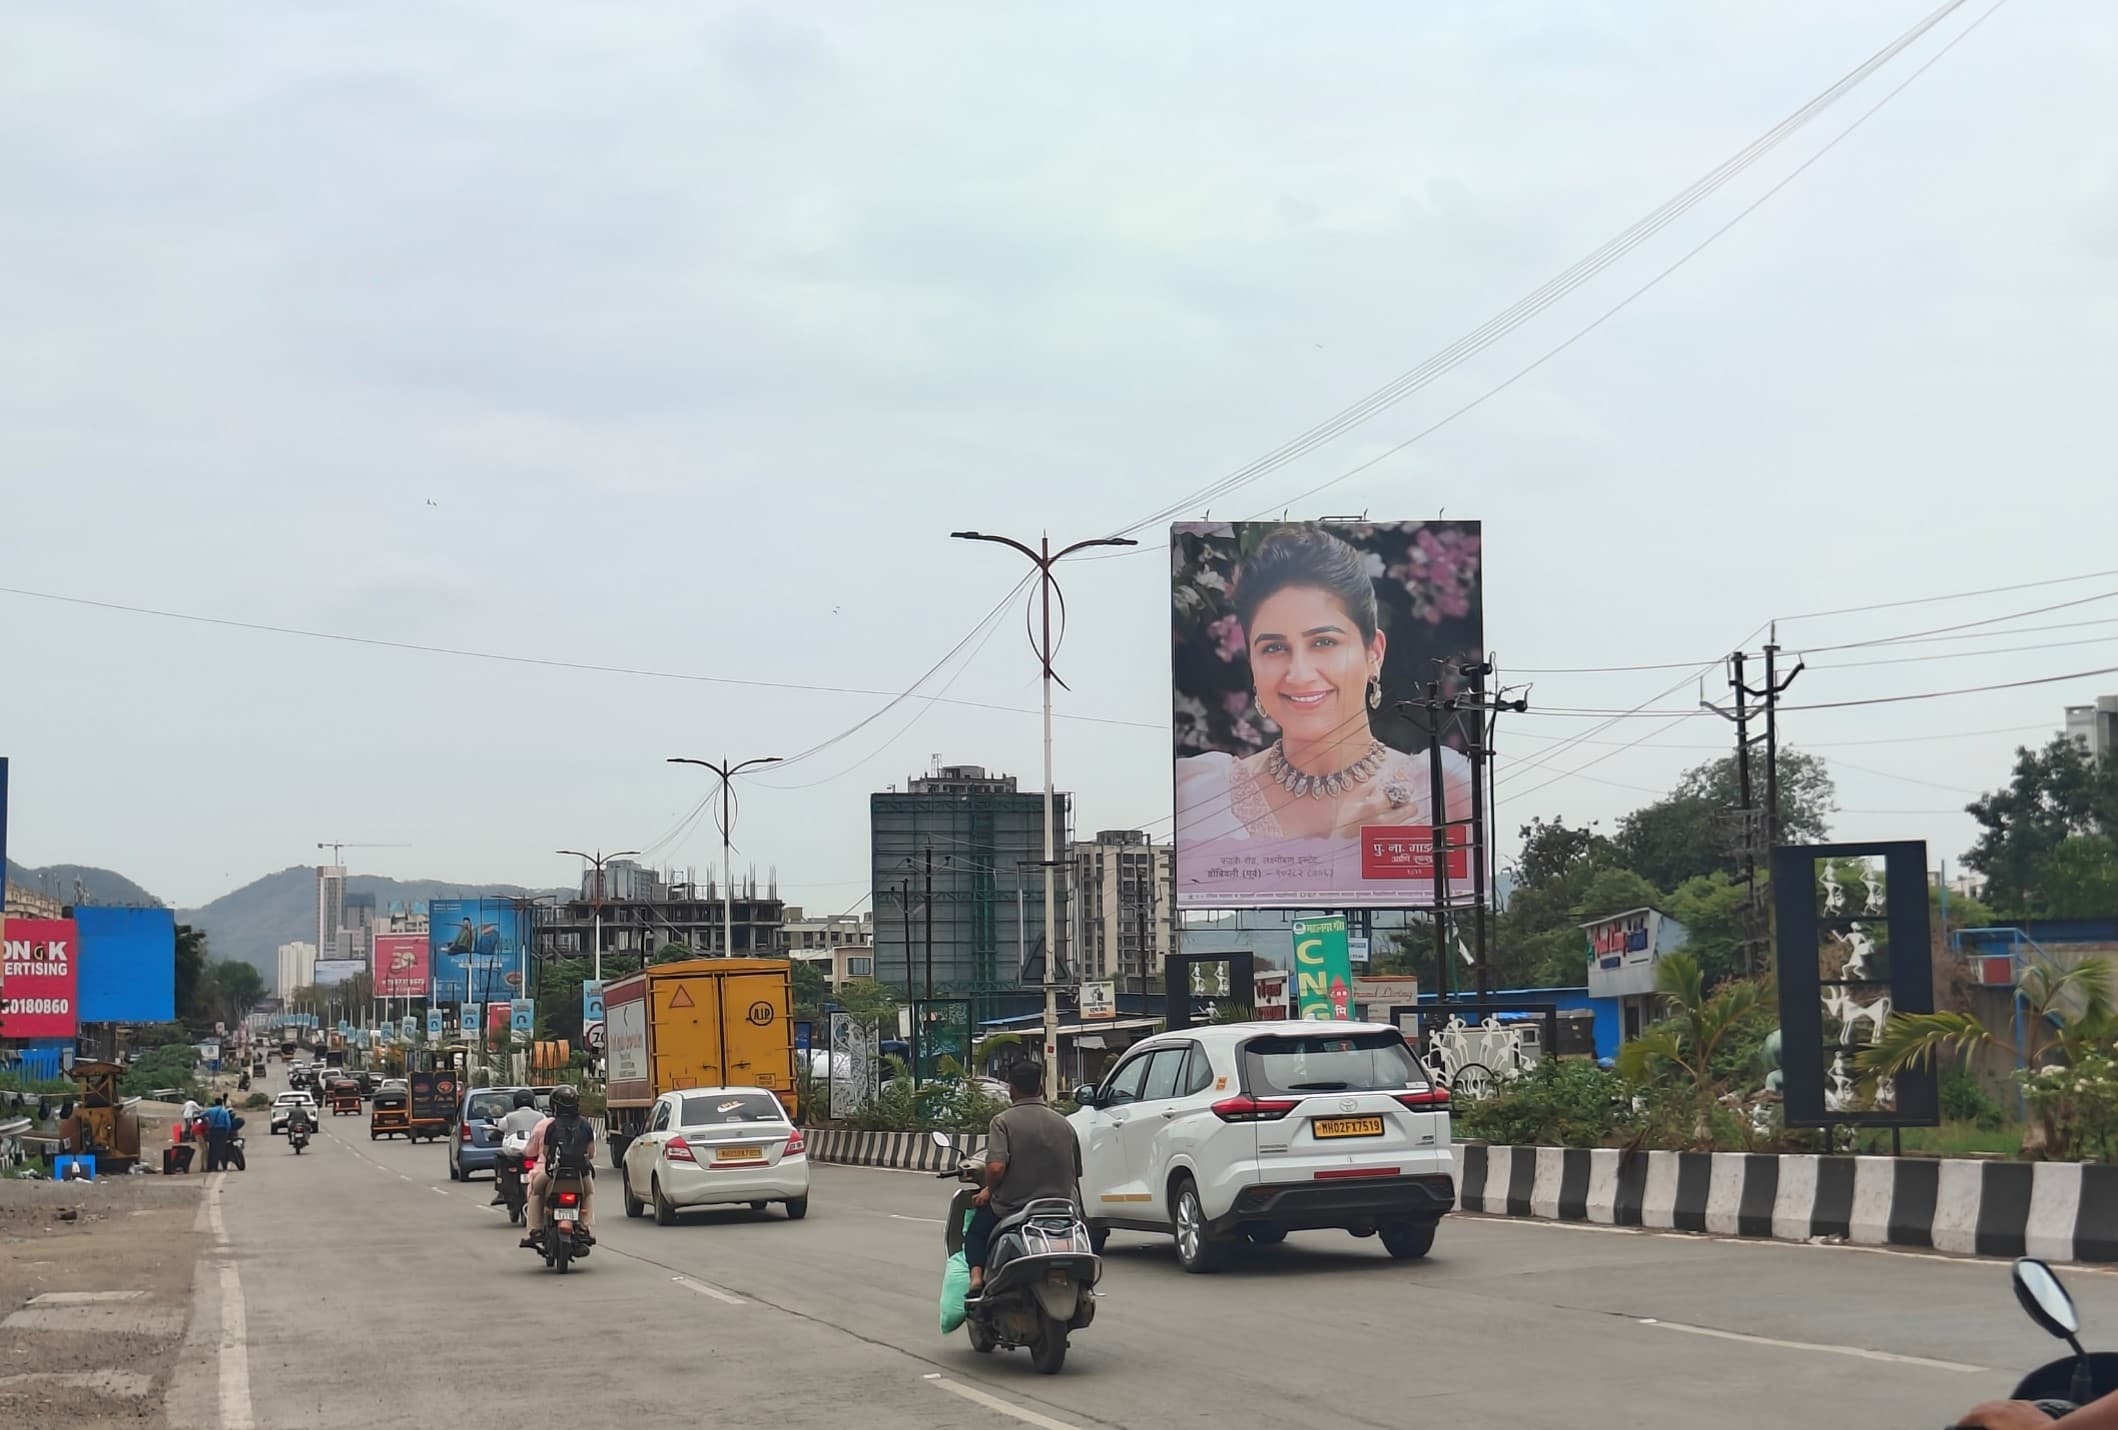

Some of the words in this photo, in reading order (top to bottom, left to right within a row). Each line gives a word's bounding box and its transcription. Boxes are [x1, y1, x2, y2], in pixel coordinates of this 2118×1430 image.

[48, 941, 68, 961] K
[4, 962, 68, 976] ERTISING
[1320, 1119, 1381, 1135] MH02FX7519
